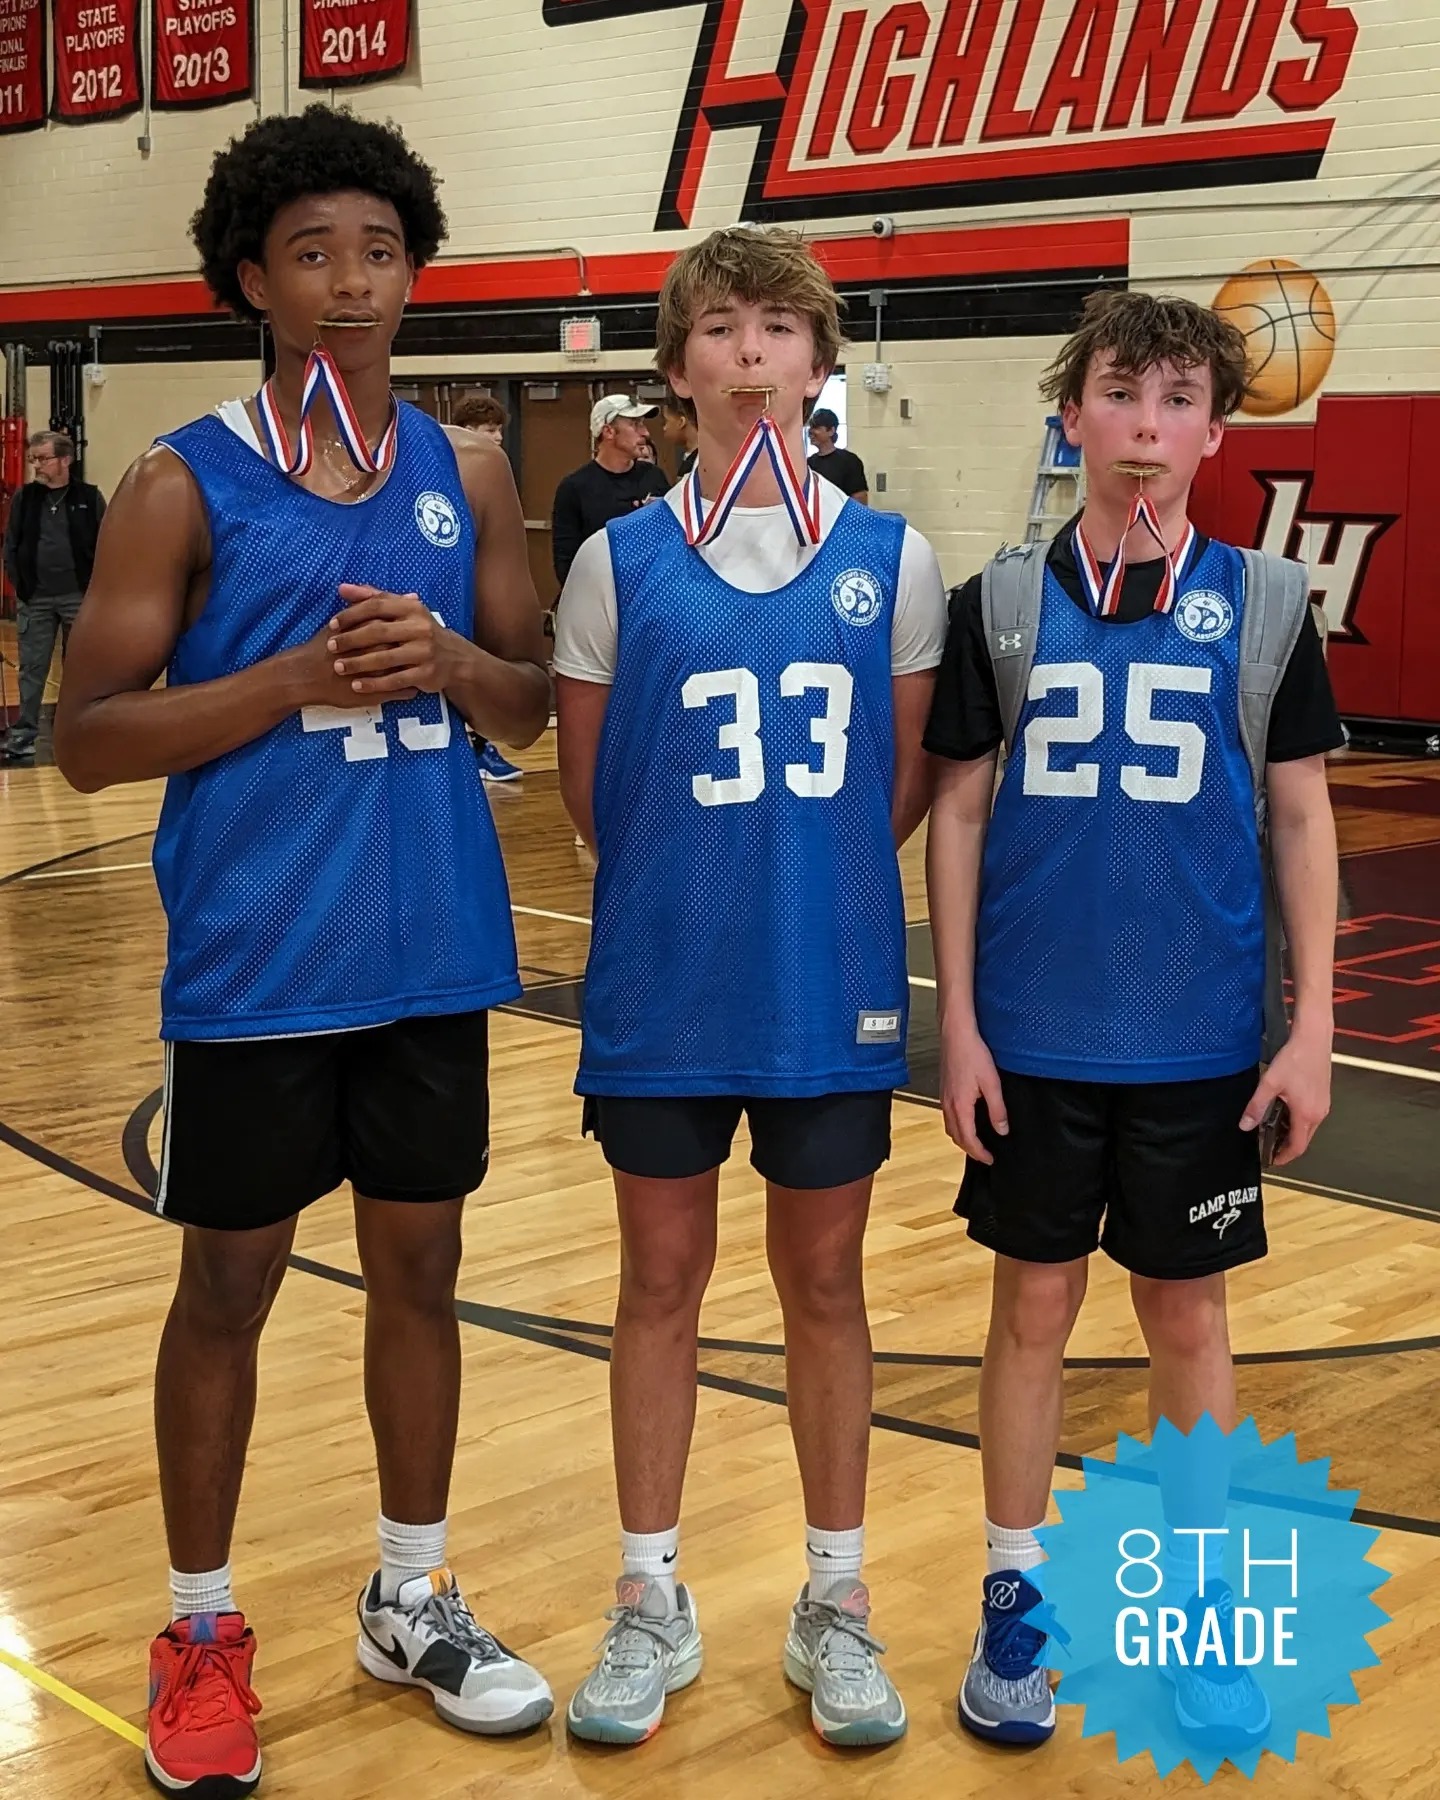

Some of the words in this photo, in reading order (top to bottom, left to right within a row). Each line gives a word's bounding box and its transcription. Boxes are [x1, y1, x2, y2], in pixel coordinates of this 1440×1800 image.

[78, 4, 117, 28] STATE
[165, 6, 236, 36] PLAYOFFS
[66, 25, 125, 54] PLAYOFFS
[321, 20, 386, 64] 2014
[71, 64, 122, 104] 2012
[173, 46, 230, 88] 2013
[654, 0, 1359, 232] HIGHLANDS
[1180, 592, 1206, 607] SPRING
[1207, 592, 1230, 612] VALLEY
[1177, 613, 1196, 637] ATHLETIC
[1195, 618, 1230, 640] ASSOCIATION
[682, 662, 853, 807] 33
[1023, 662, 1212, 804] 25
[1189, 1194, 1226, 1223] CAMP
